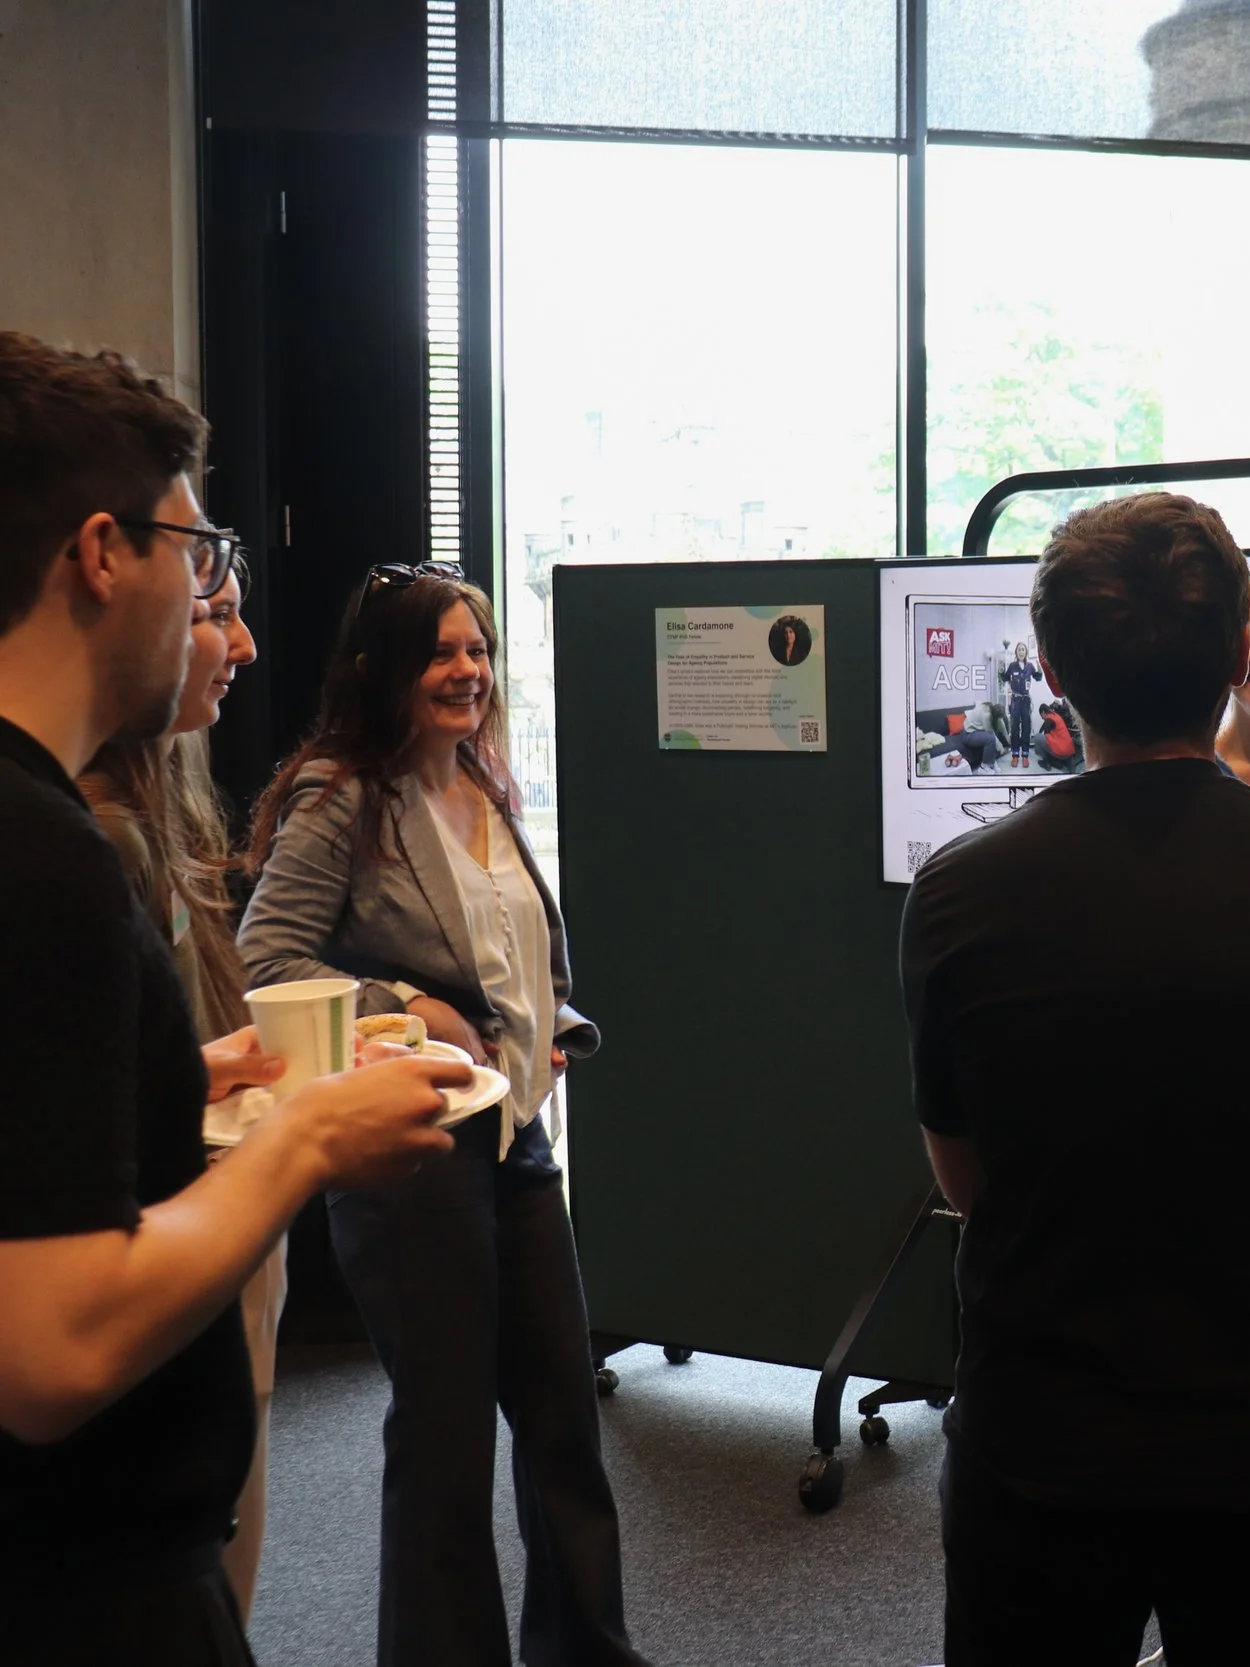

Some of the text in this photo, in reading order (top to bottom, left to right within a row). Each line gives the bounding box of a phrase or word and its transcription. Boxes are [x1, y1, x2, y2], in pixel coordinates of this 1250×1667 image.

[666, 621, 734, 631] Elisa Cardamone
[929, 631, 951, 643] ASK
[932, 664, 988, 691] AGE
